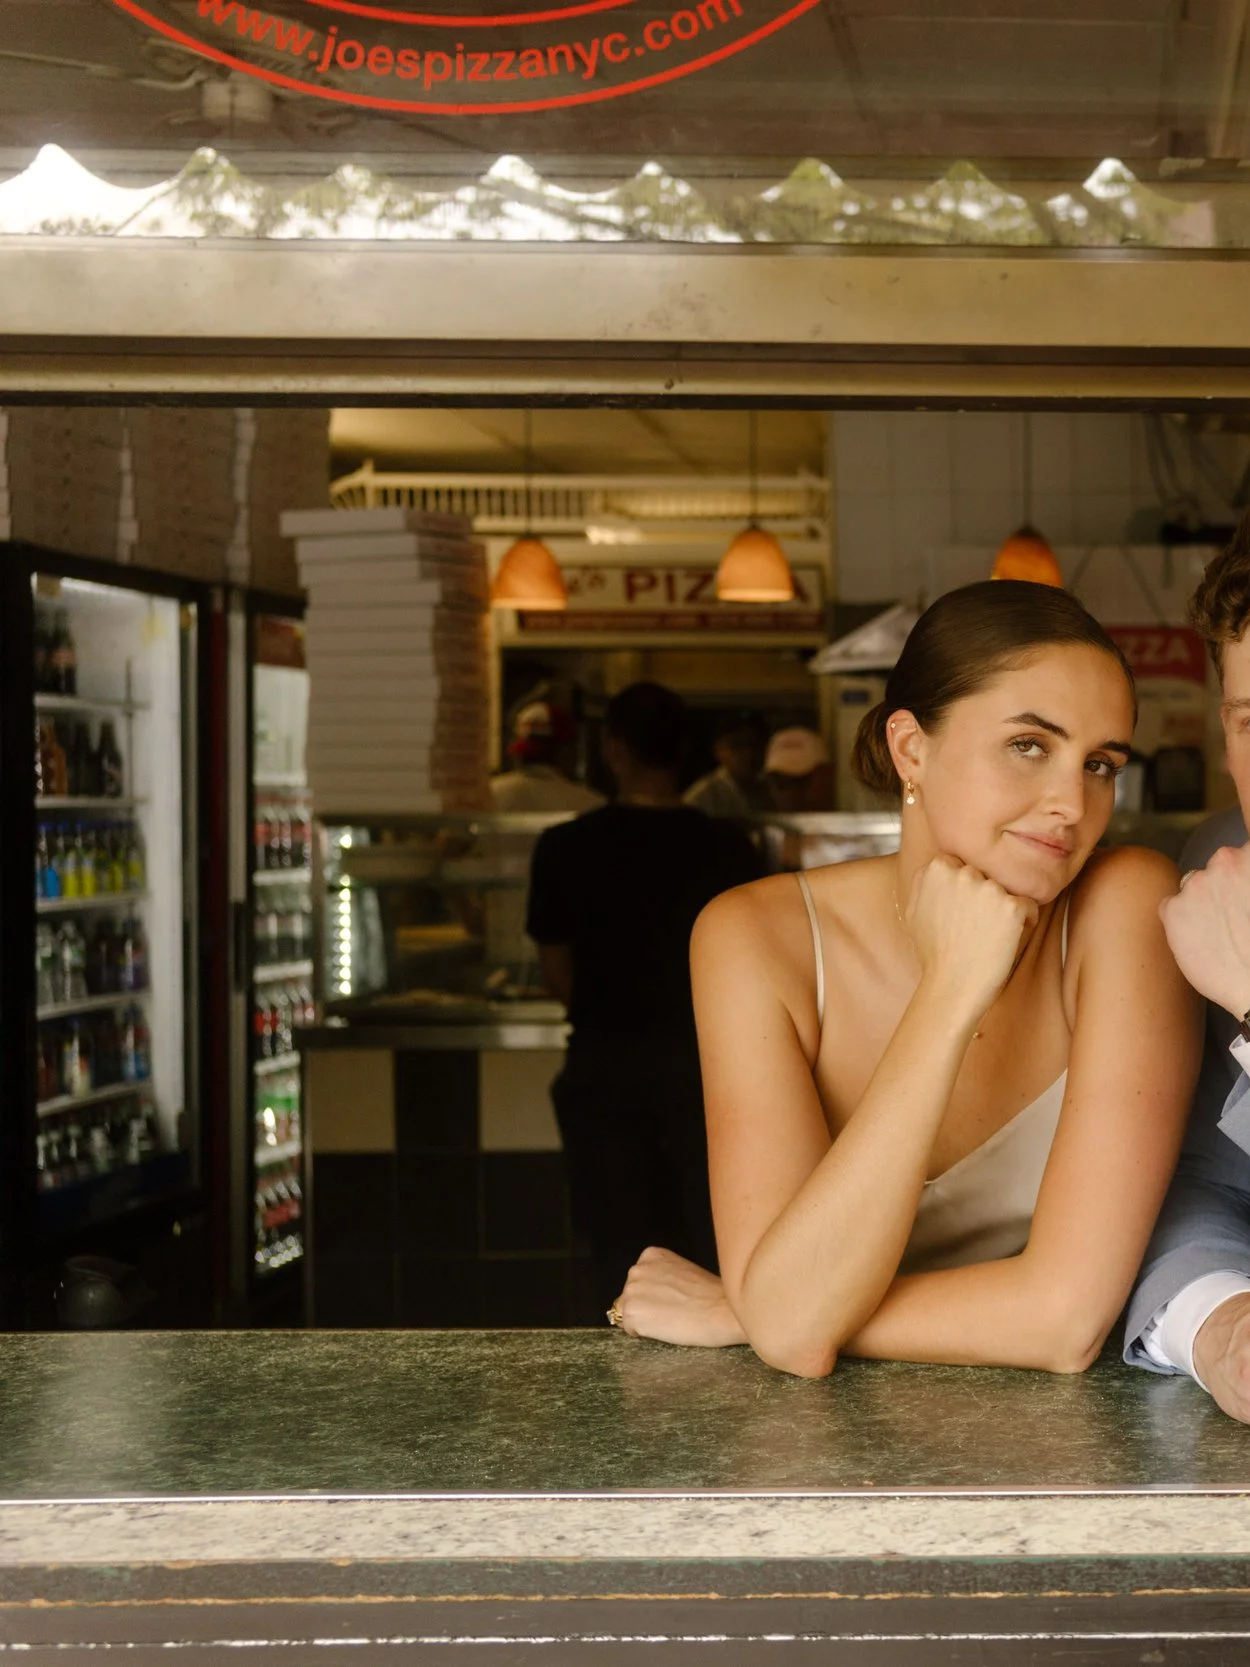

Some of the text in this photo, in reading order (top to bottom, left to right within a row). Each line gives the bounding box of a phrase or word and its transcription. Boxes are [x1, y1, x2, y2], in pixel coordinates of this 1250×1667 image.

[197, 0, 744, 91] www.joespizzanyc.com
[624, 565, 810, 605] PIZA
[1114, 634, 1191, 665] ZZA
